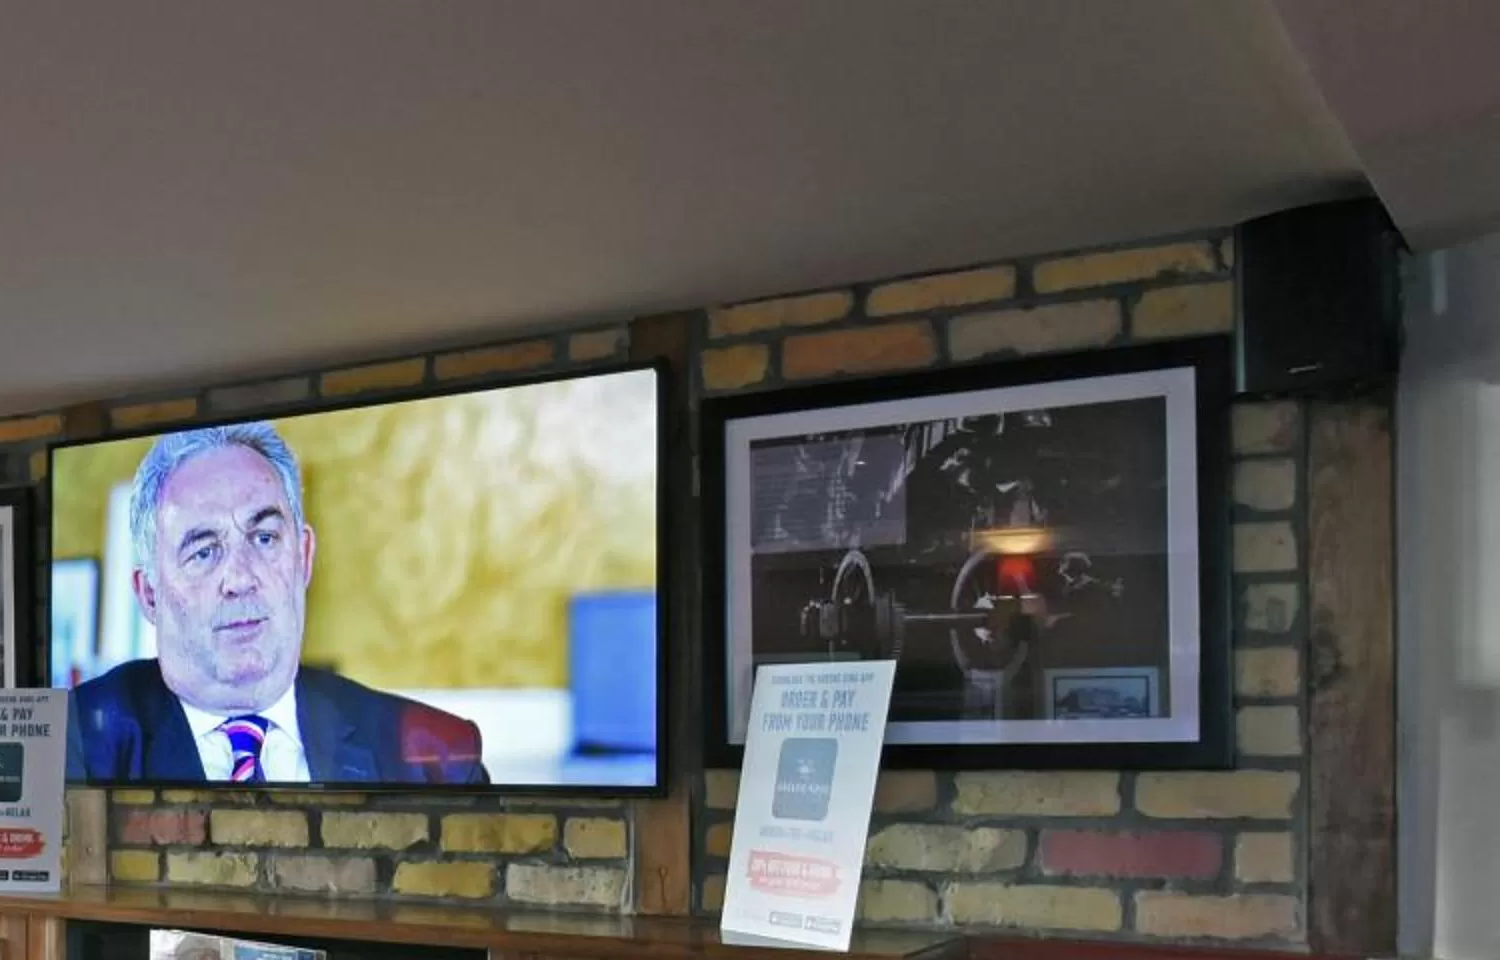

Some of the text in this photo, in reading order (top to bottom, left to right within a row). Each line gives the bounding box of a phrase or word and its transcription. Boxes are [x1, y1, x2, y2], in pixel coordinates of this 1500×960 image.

[832, 689, 856, 708] PAY
[0, 707, 8, 721] &
[12, 707, 34, 721] PAY
[762, 712, 792, 732] FROM
[828, 712, 870, 732] PHONE
[11, 723, 52, 737] PHONE
